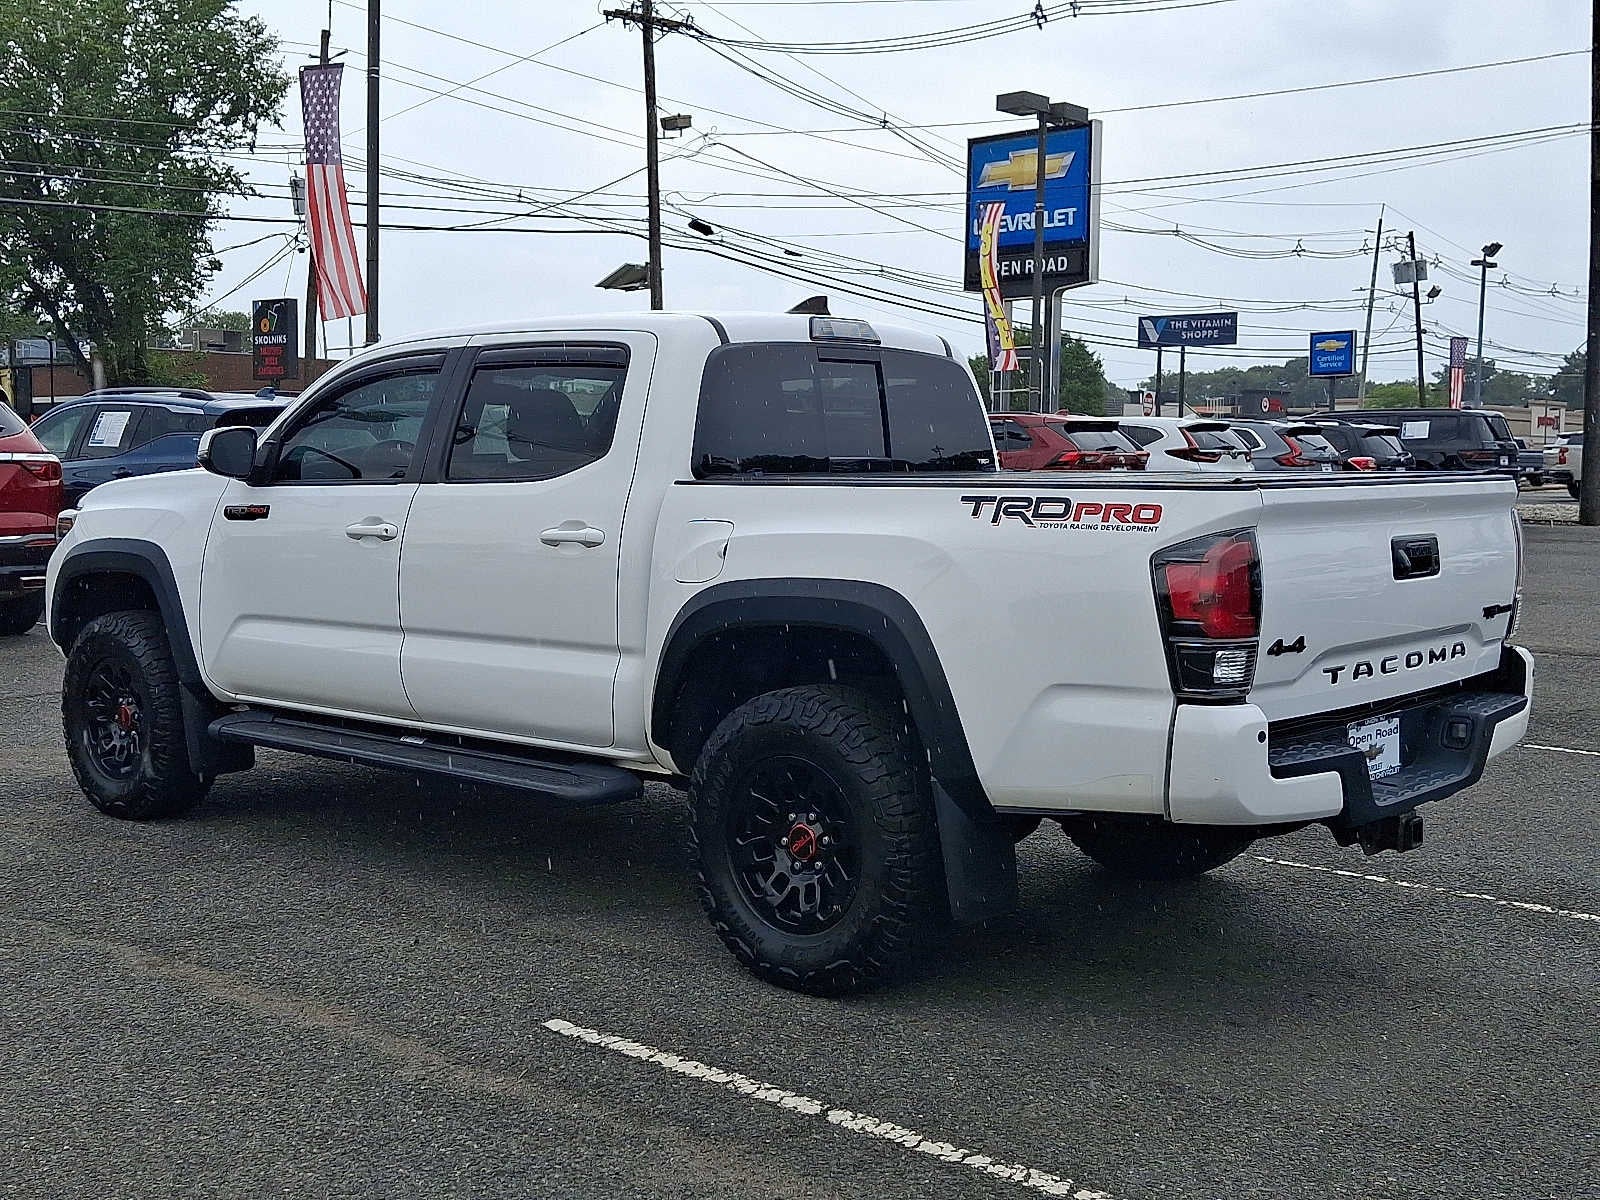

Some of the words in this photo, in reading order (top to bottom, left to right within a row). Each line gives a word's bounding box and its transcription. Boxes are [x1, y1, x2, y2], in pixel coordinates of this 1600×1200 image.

[973, 207, 1077, 236] EVRLET
[996, 261, 1020, 277] PEN
[981, 222, 1013, 350] SALE
[1169, 320, 1189, 329] THE
[1190, 318, 1232, 328] VITAMIN
[254, 334, 287, 345] SKOLNIKS
[1181, 329, 1219, 339] SHOPPE
[1316, 354, 1345, 362] Certified
[1039, 522, 1069, 530] TOYOTA
[1069, 523, 1099, 531] RACING
[1100, 524, 1160, 533] DEVELOPMENT
[1322, 640, 1467, 685] TACOMA
[1349, 733, 1372, 747] Open
[1375, 724, 1399, 740] Road
